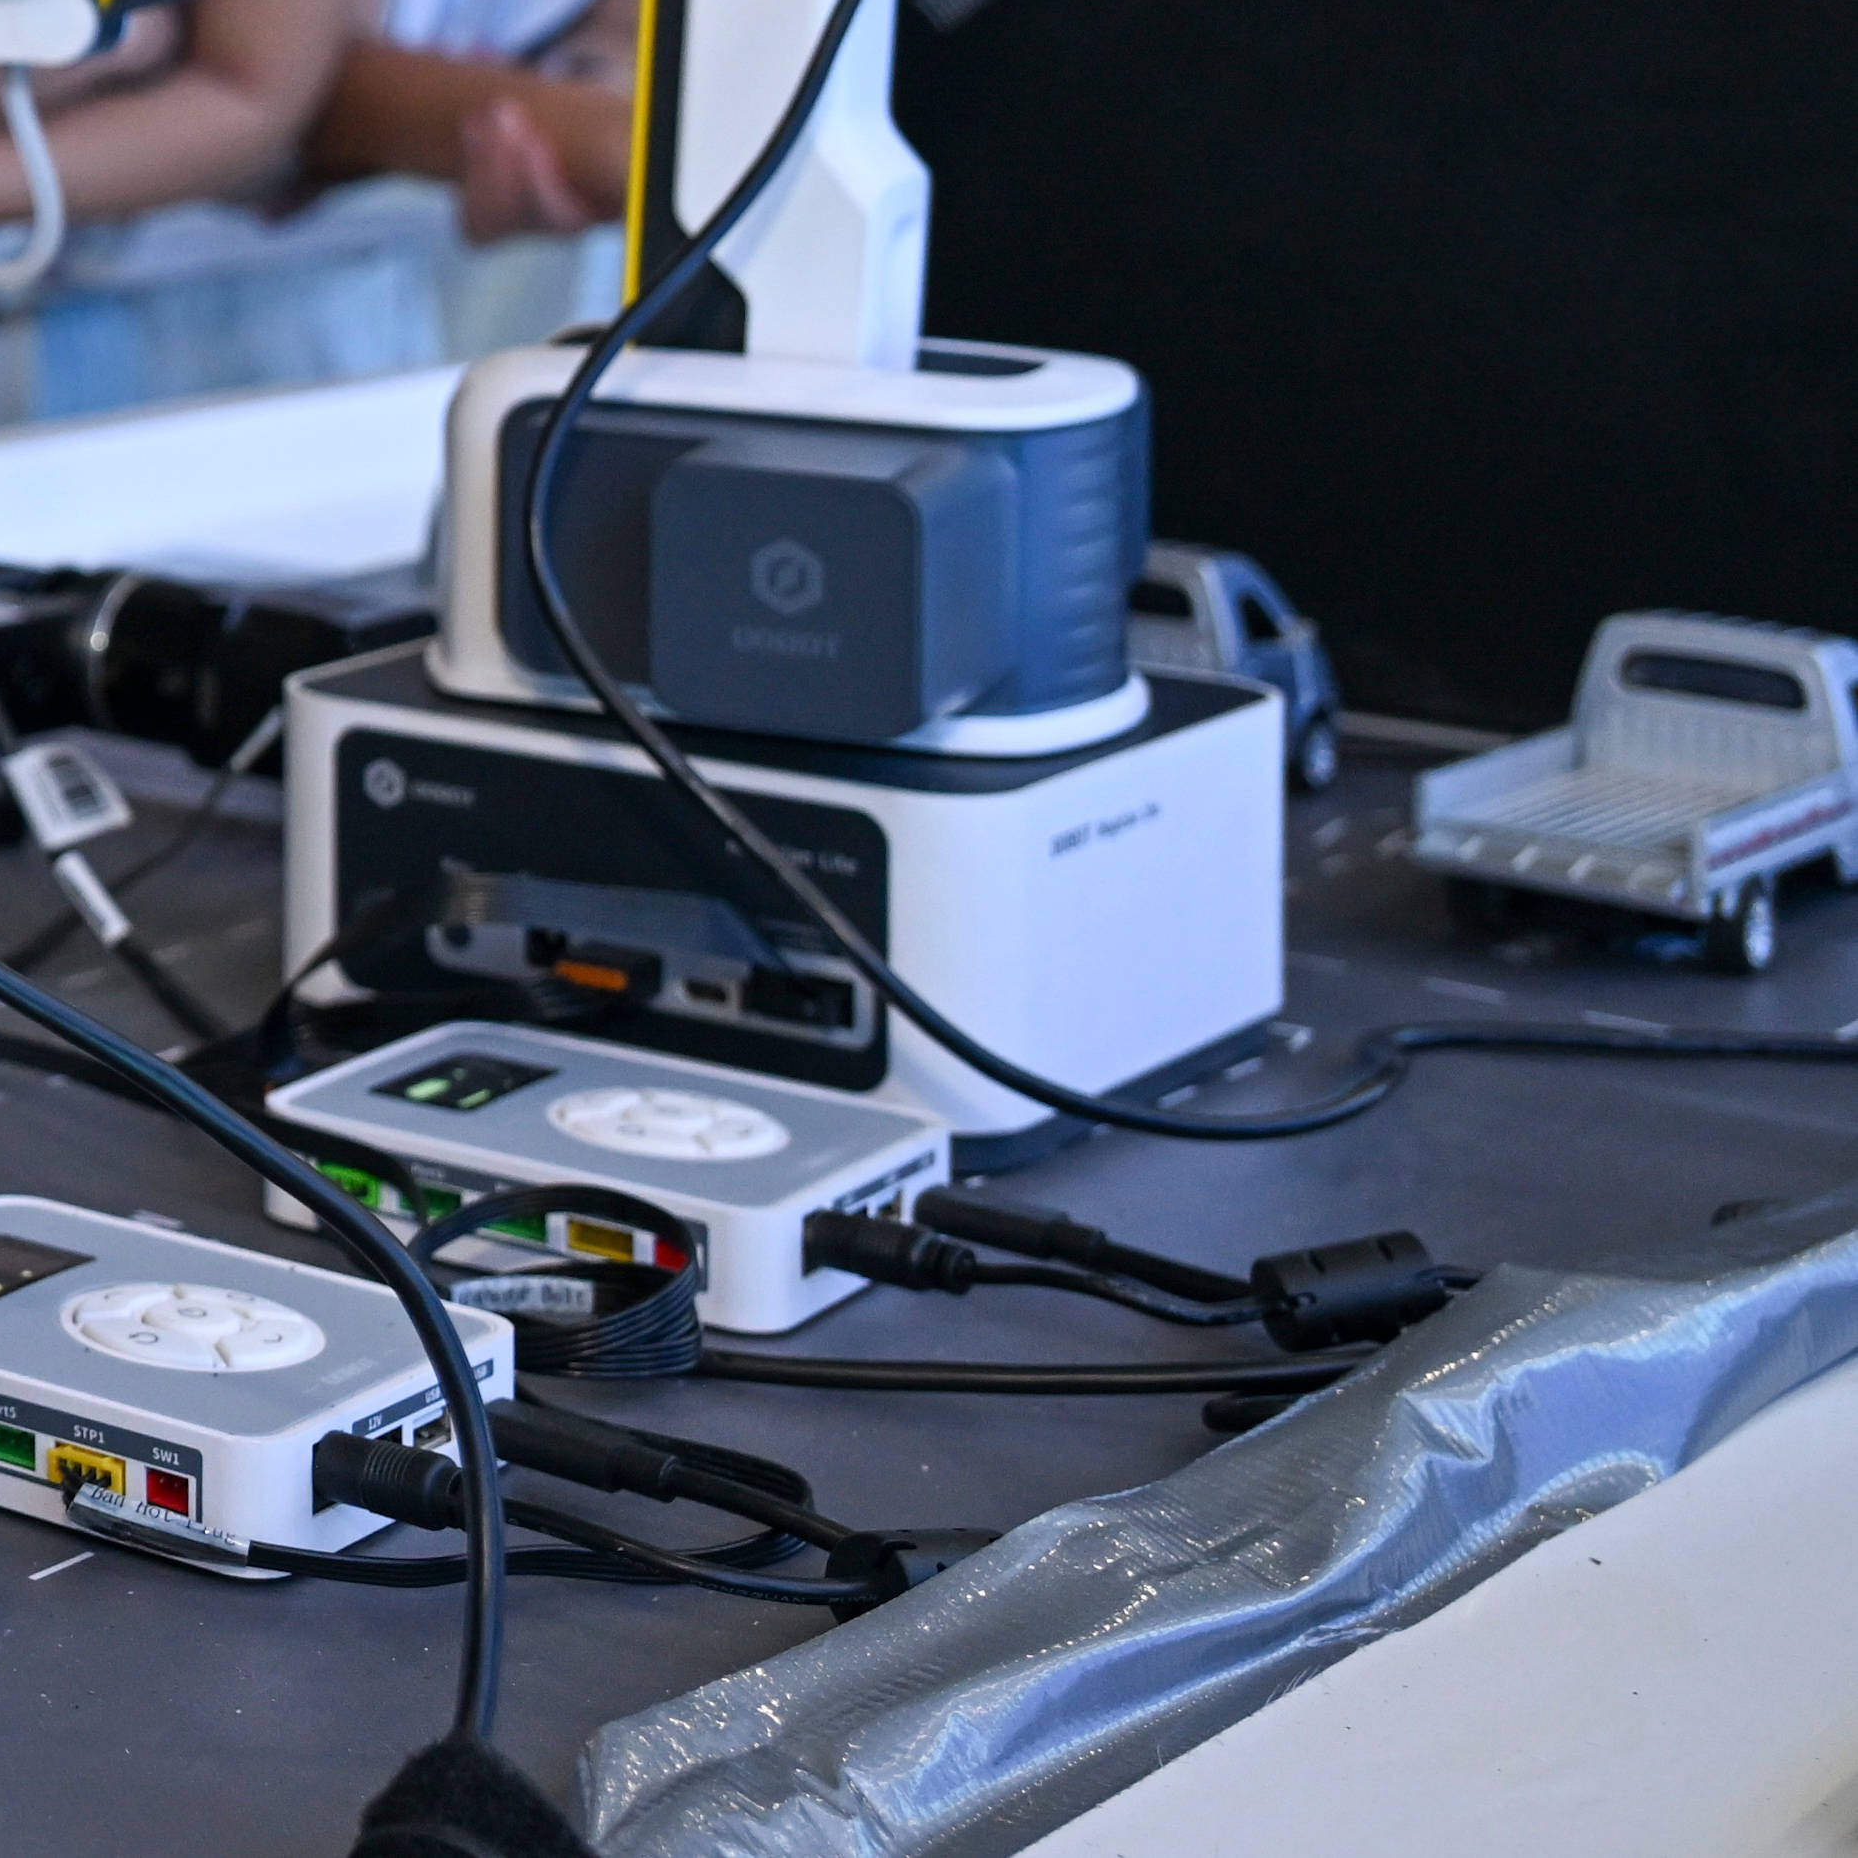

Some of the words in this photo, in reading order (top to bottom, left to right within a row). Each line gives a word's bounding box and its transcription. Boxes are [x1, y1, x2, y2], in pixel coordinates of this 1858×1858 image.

[73, 1424, 105, 1443] STP1
[152, 1446, 180, 1466] SW1
[91, 1486, 125, 1508] Ban
